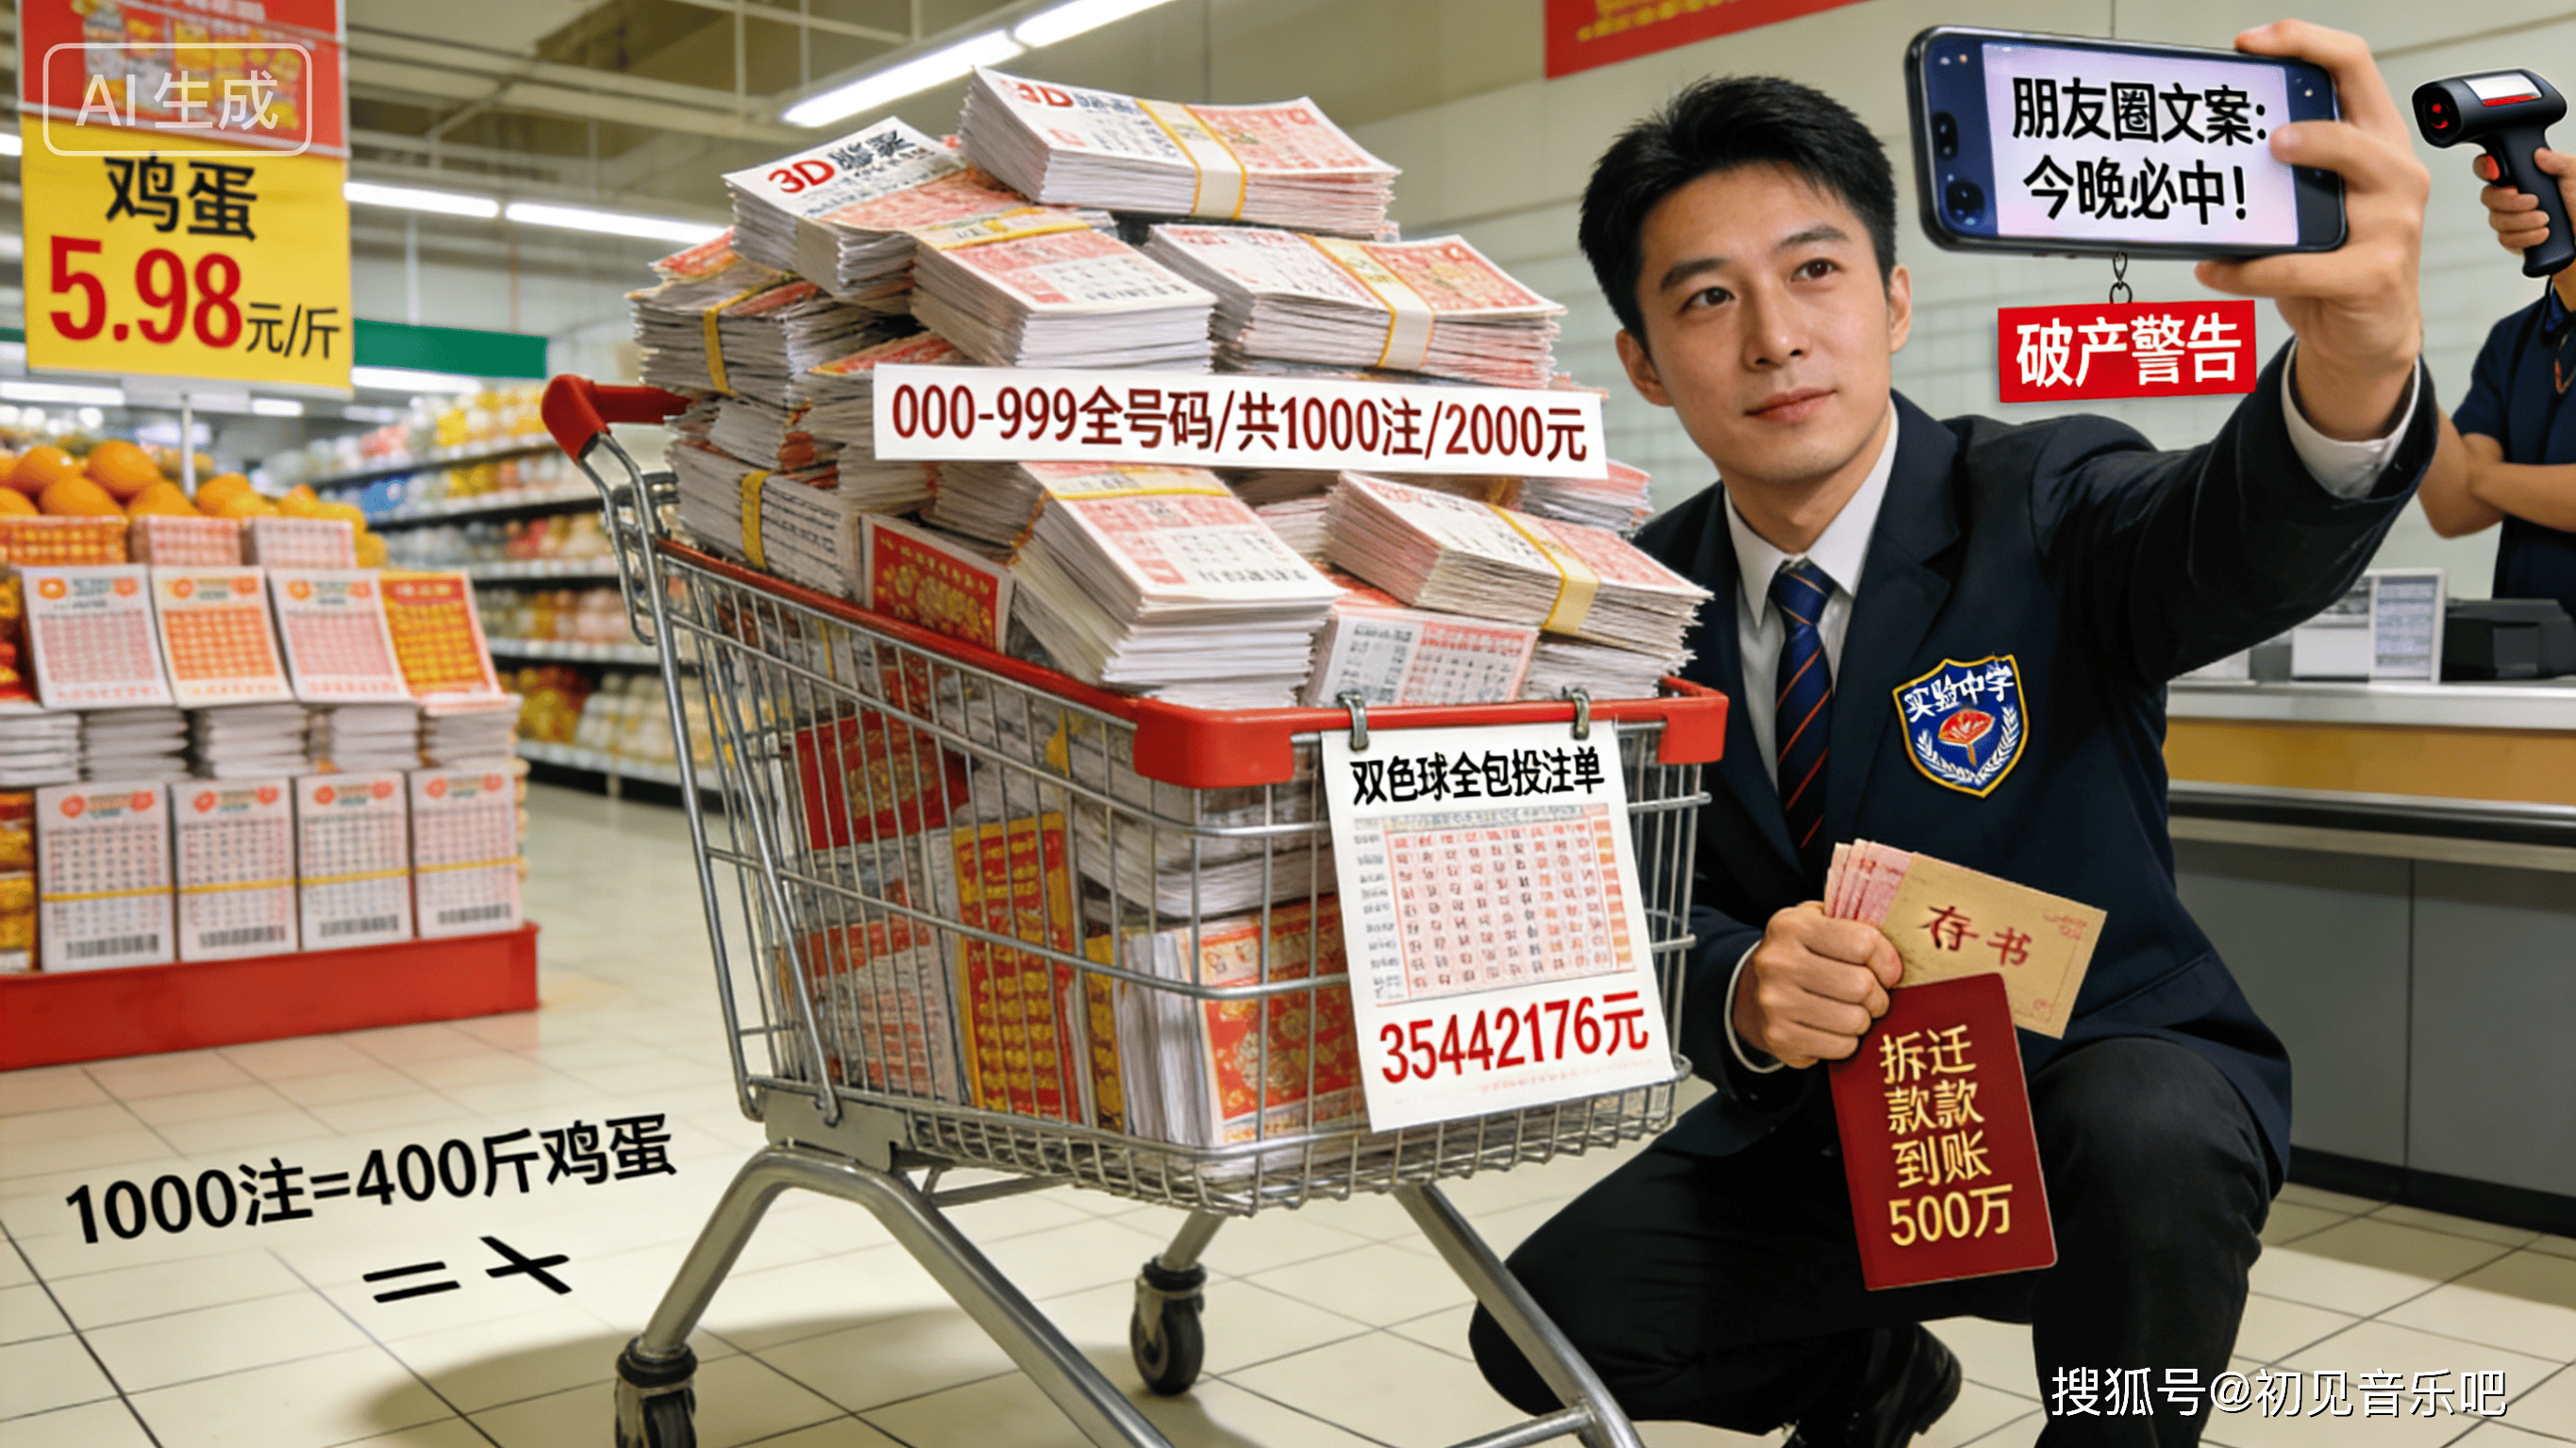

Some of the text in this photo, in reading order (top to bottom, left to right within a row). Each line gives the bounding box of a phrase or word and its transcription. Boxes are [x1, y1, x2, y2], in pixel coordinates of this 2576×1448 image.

[2012, 77, 2267, 147] 朋友圈文案:
[104, 154, 258, 241] 鸡蛋
[2022, 155, 2247, 225] 今晚必中!
[2016, 312, 2242, 388] 破产警告
[892, 383, 1588, 463] 000-999全号码/共1000注/2000元
[1349, 746, 1605, 806] 双色球全包投注单
[1380, 990, 1649, 1085] 35442176元
[1879, 1022, 1978, 1084] 拆迁
[1883, 1078, 1985, 1135] 款款
[65, 1112, 677, 1244] 1000注=400斤鸡蛋
[1891, 1129, 1993, 1190] 到账
[1889, 1183, 2014, 1246] 500万
